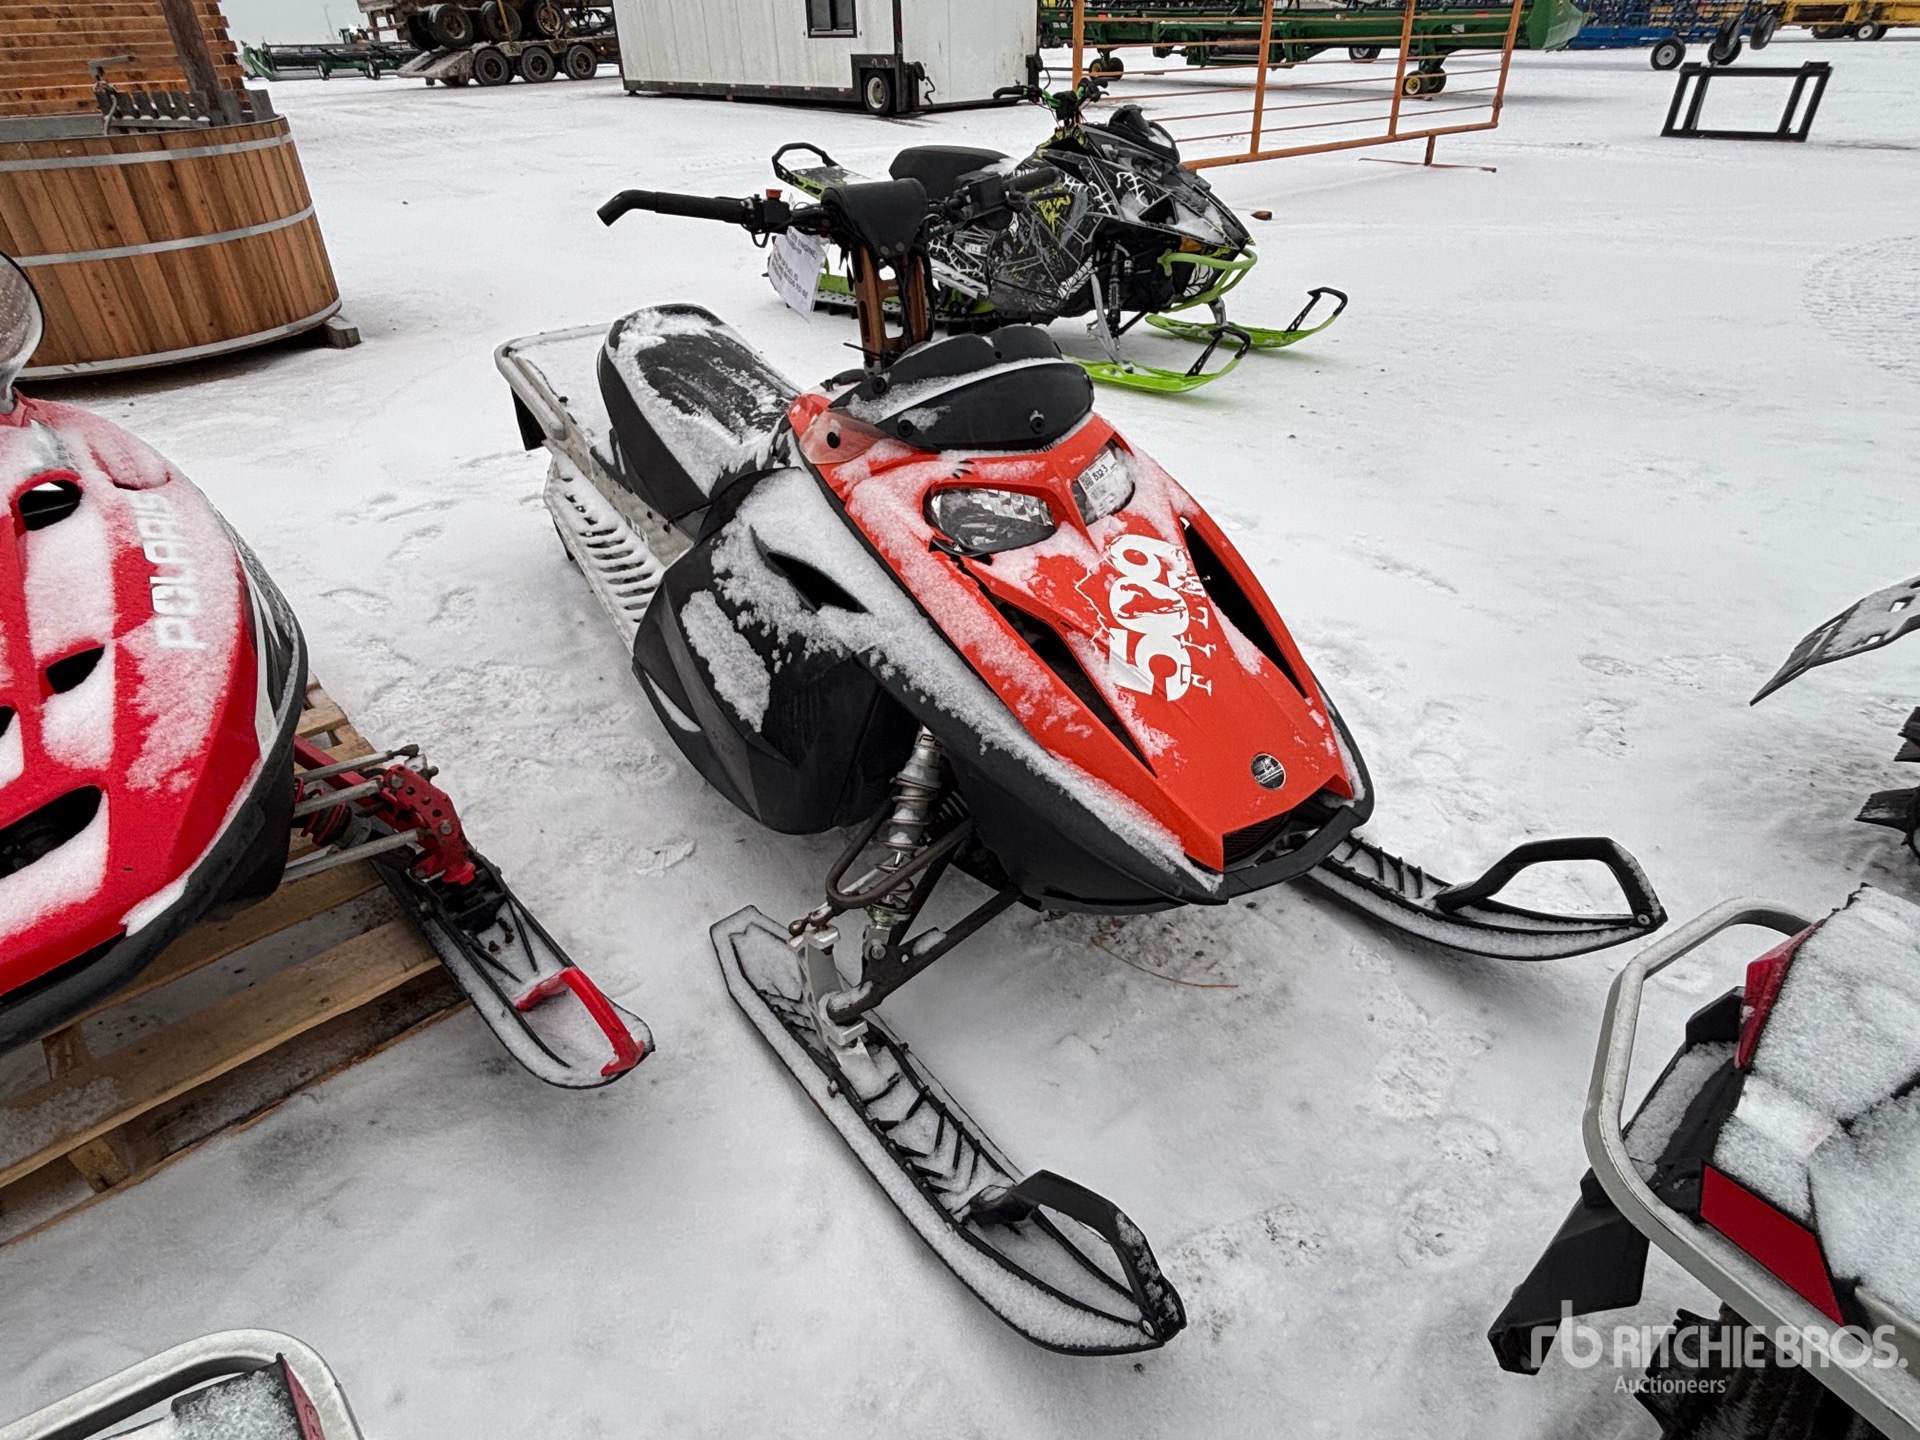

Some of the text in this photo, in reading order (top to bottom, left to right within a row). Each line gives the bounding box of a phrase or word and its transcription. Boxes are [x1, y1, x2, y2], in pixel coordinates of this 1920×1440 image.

[129, 491, 208, 649] POLARIS
[1109, 534, 1192, 702] 509
[1177, 554, 1217, 698] FILM
